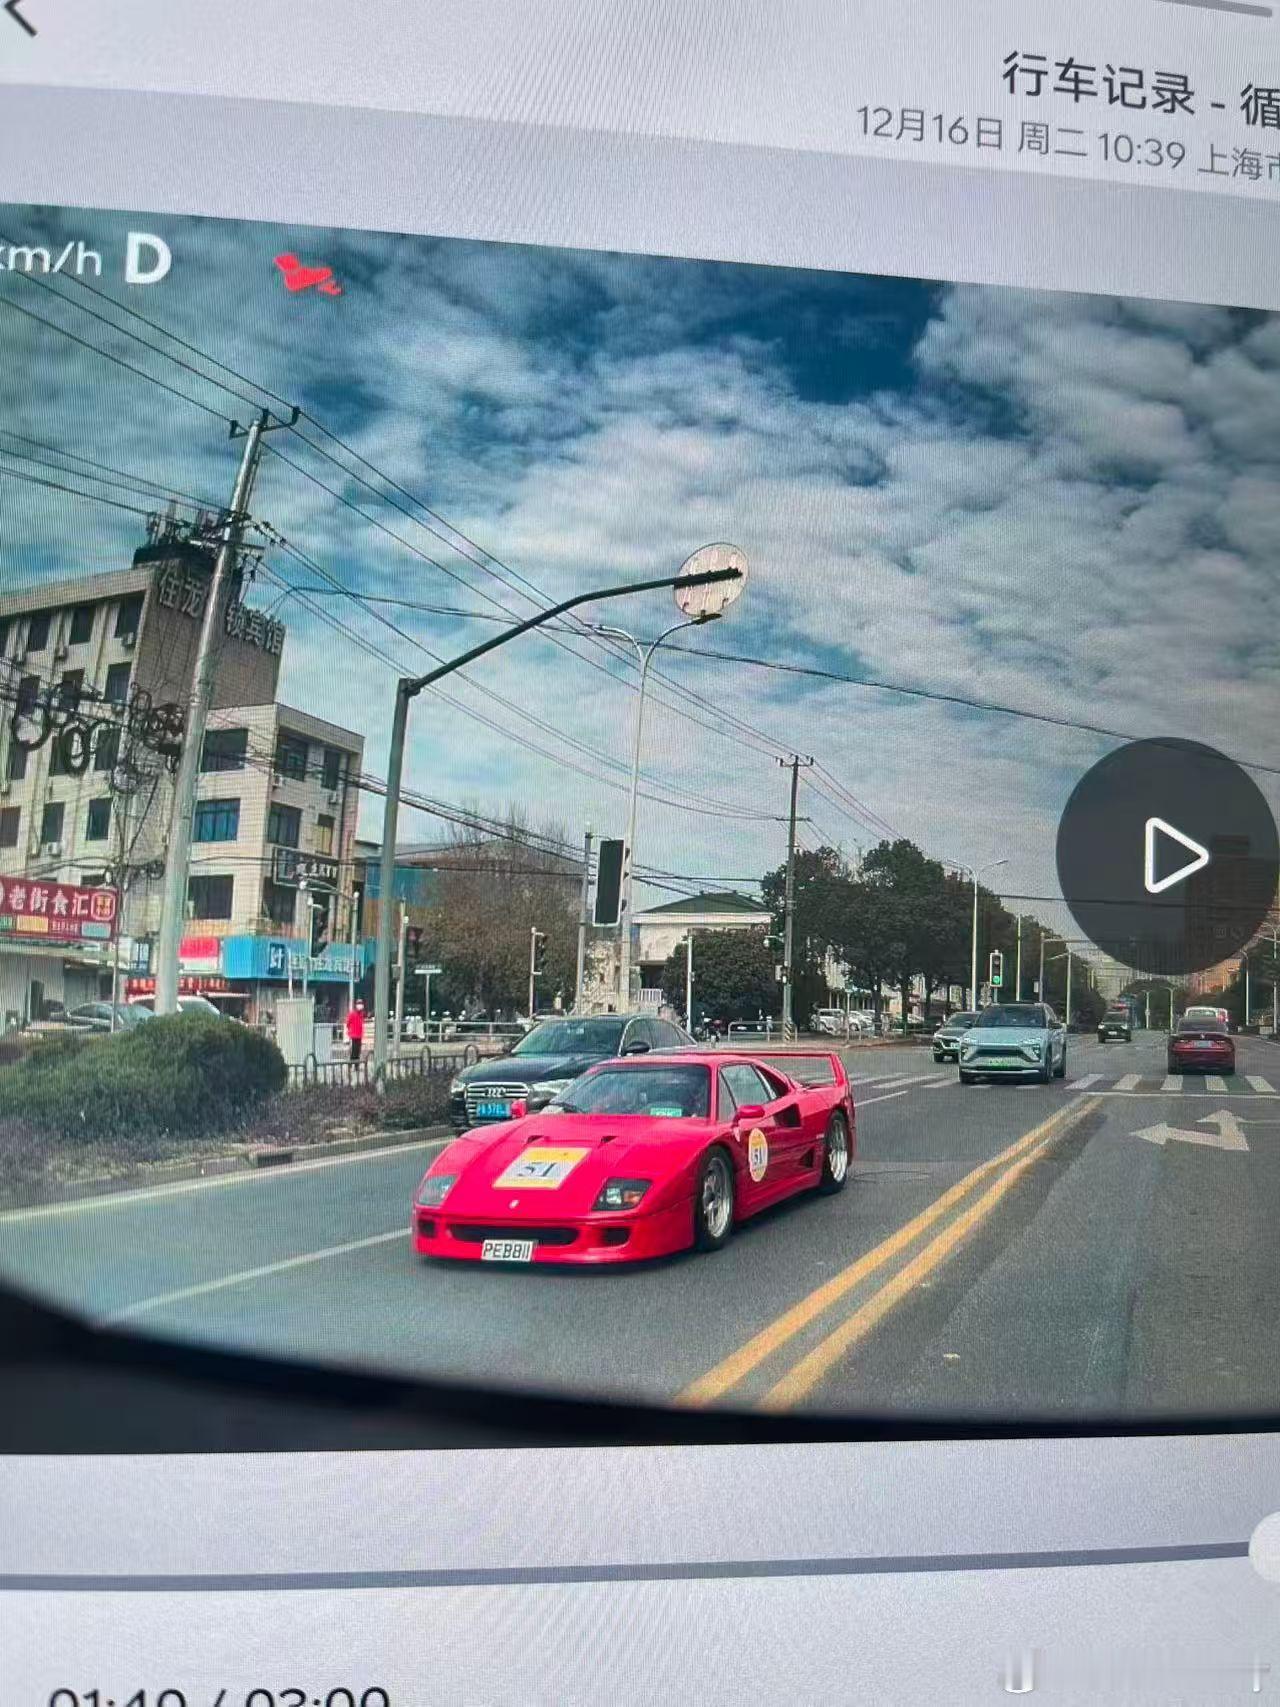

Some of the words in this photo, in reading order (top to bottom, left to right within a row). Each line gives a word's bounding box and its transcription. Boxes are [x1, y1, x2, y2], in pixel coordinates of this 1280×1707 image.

[1002, 50, 1195, 115] 行车记录
[856, 105, 1003, 150] 12月16日
[1018, 120, 1088, 157] 周二
[1098, 132, 1186, 169] 10:39
[0, 241, 102, 276] m/h
[125, 231, 172, 284] D
